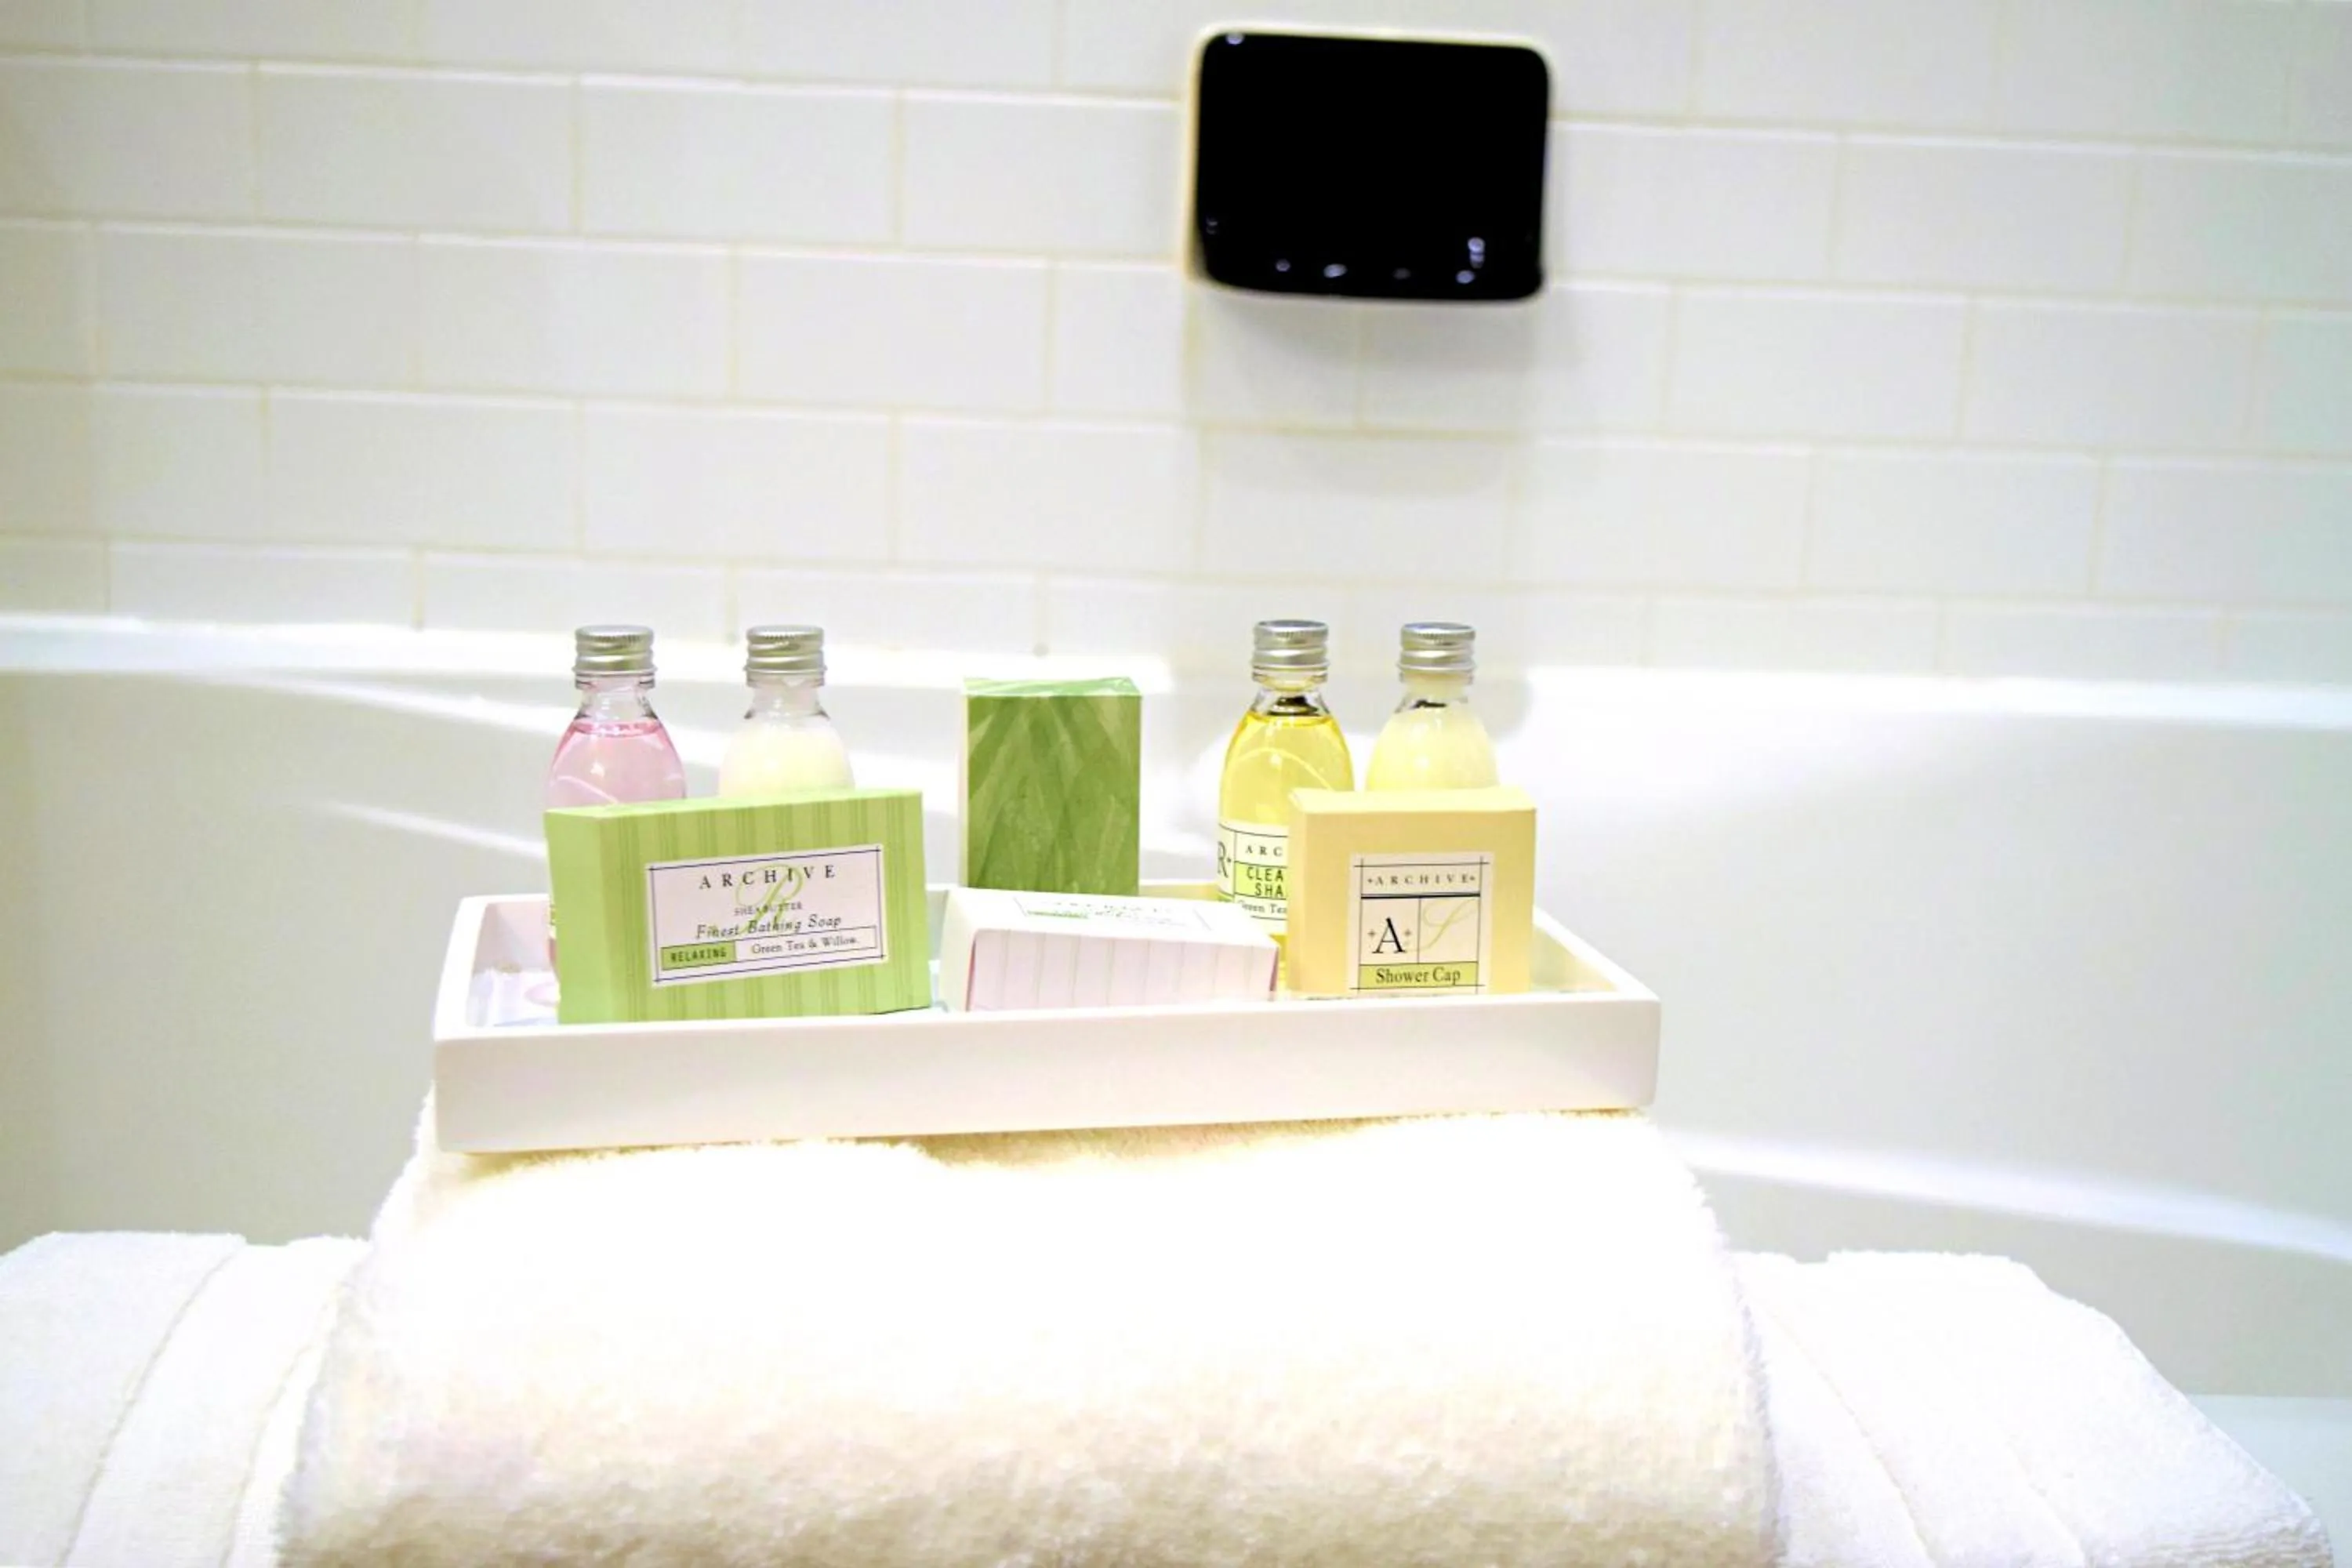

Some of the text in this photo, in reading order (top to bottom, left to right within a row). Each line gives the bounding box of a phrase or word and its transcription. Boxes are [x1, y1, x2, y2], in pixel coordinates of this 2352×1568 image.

[699, 865, 836, 890] ARCHIVE
[1247, 867, 1283, 882] CLEA
[1376, 874, 1468, 885] ARCHIVE
[1255, 883, 1283, 896] SHA
[696, 913, 841, 939] Finest Bathing Soap
[1372, 916, 1406, 953] A
[752, 943, 782, 954] Green
[786, 940, 805, 950] Tea
[808, 938, 817, 949] &
[670, 947, 727, 963] RELAXING
[1376, 967, 1461, 985] Shower Cap
